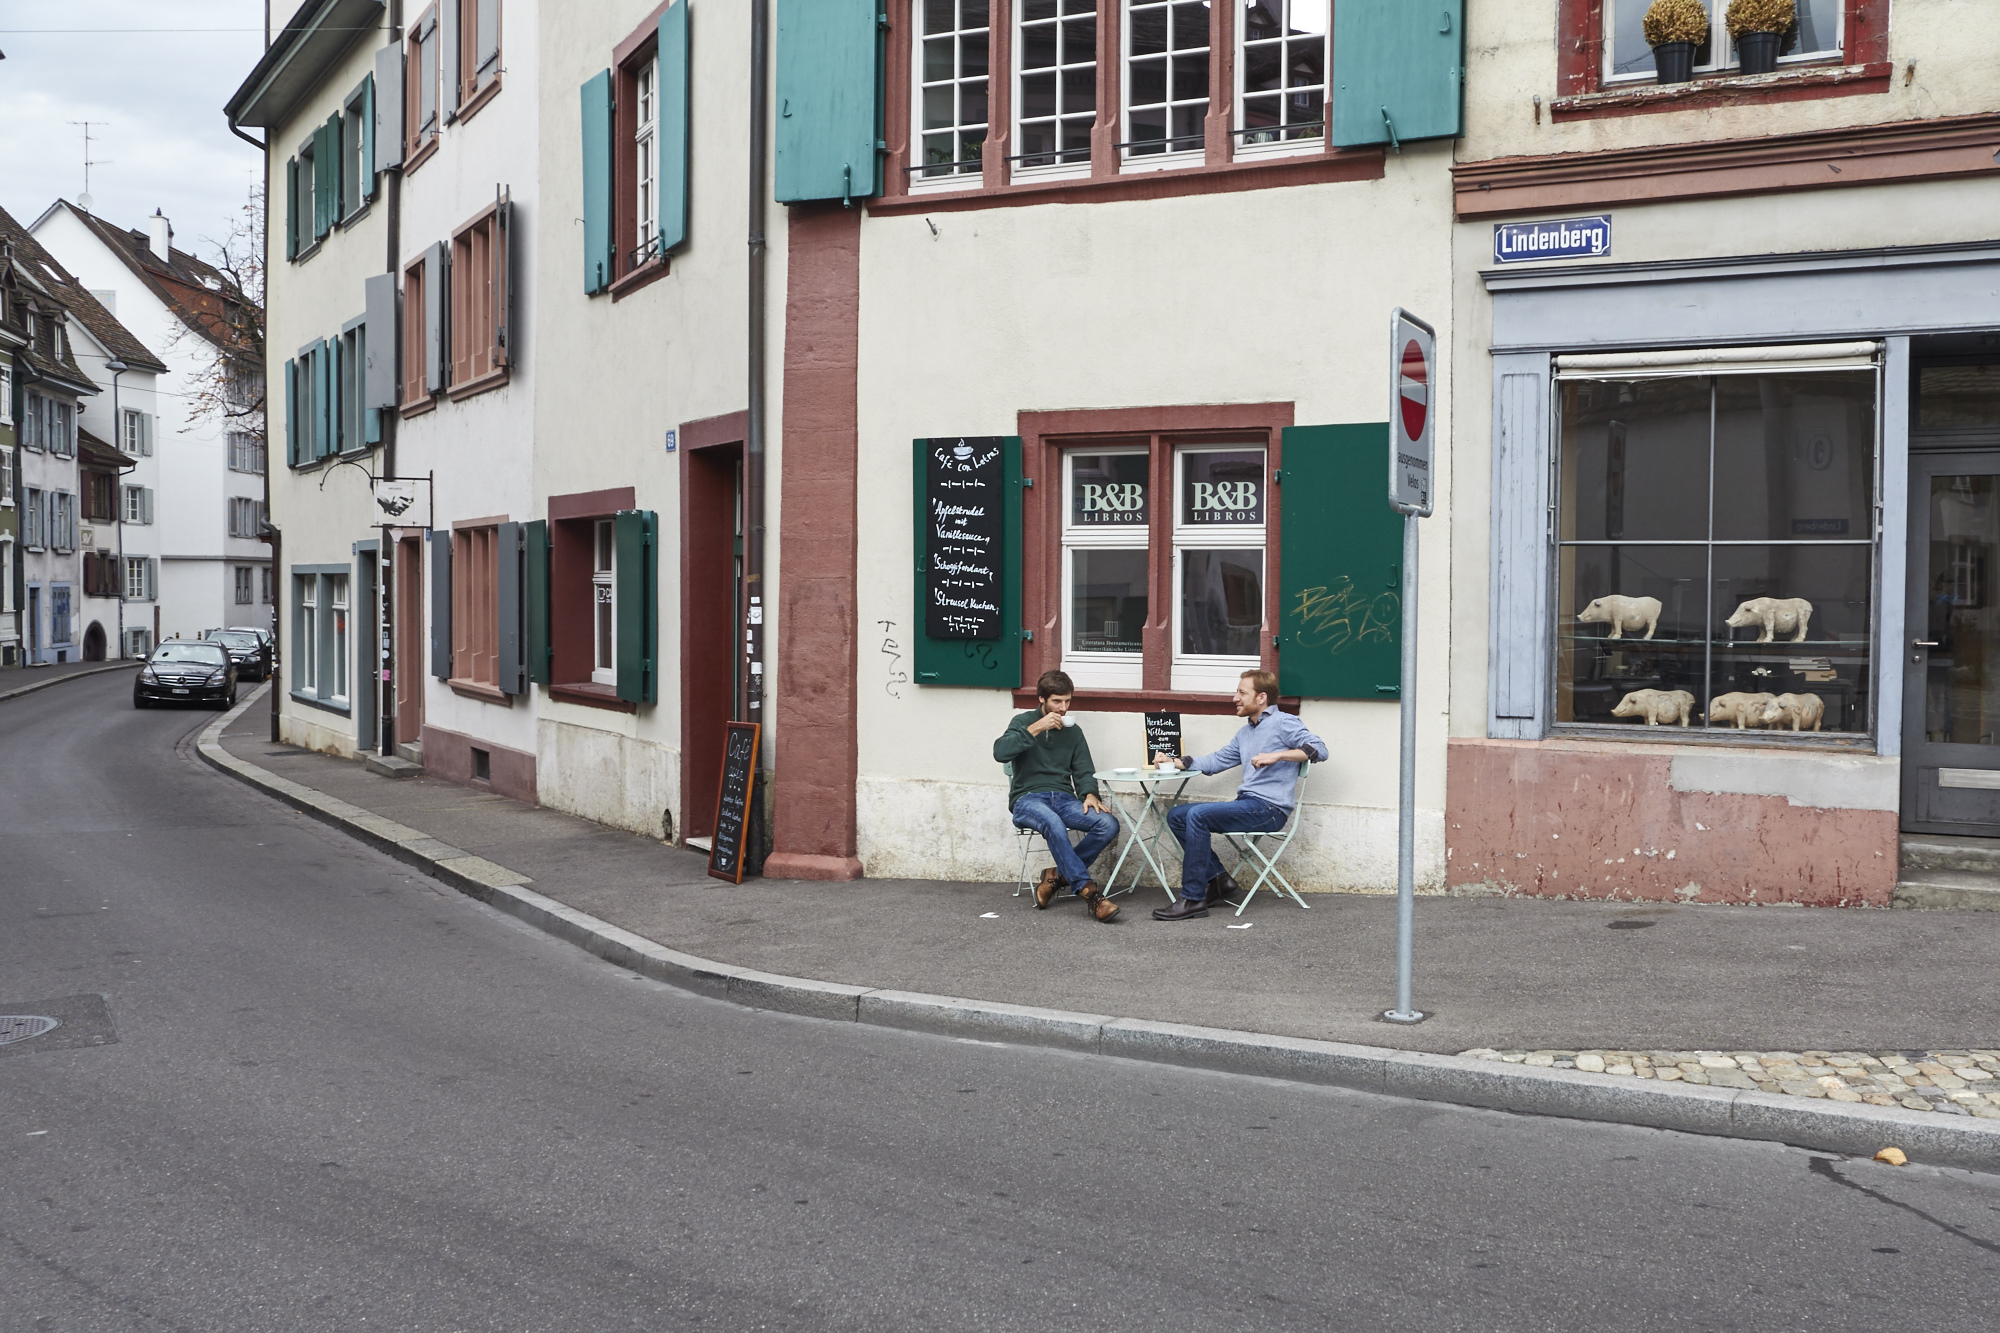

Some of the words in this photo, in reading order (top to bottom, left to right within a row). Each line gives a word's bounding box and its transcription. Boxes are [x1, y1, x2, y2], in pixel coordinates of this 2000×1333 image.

[1502, 224, 1603, 253] Lindenberg
[1398, 452, 1428, 471] ausgenommen
[1407, 473, 1419, 489] Velos
[1081, 483, 1144, 512] B&B
[1191, 481, 1257, 511] B&B
[1083, 512, 1143, 522] LIBROS
[1193, 511, 1256, 521] LIBROS
